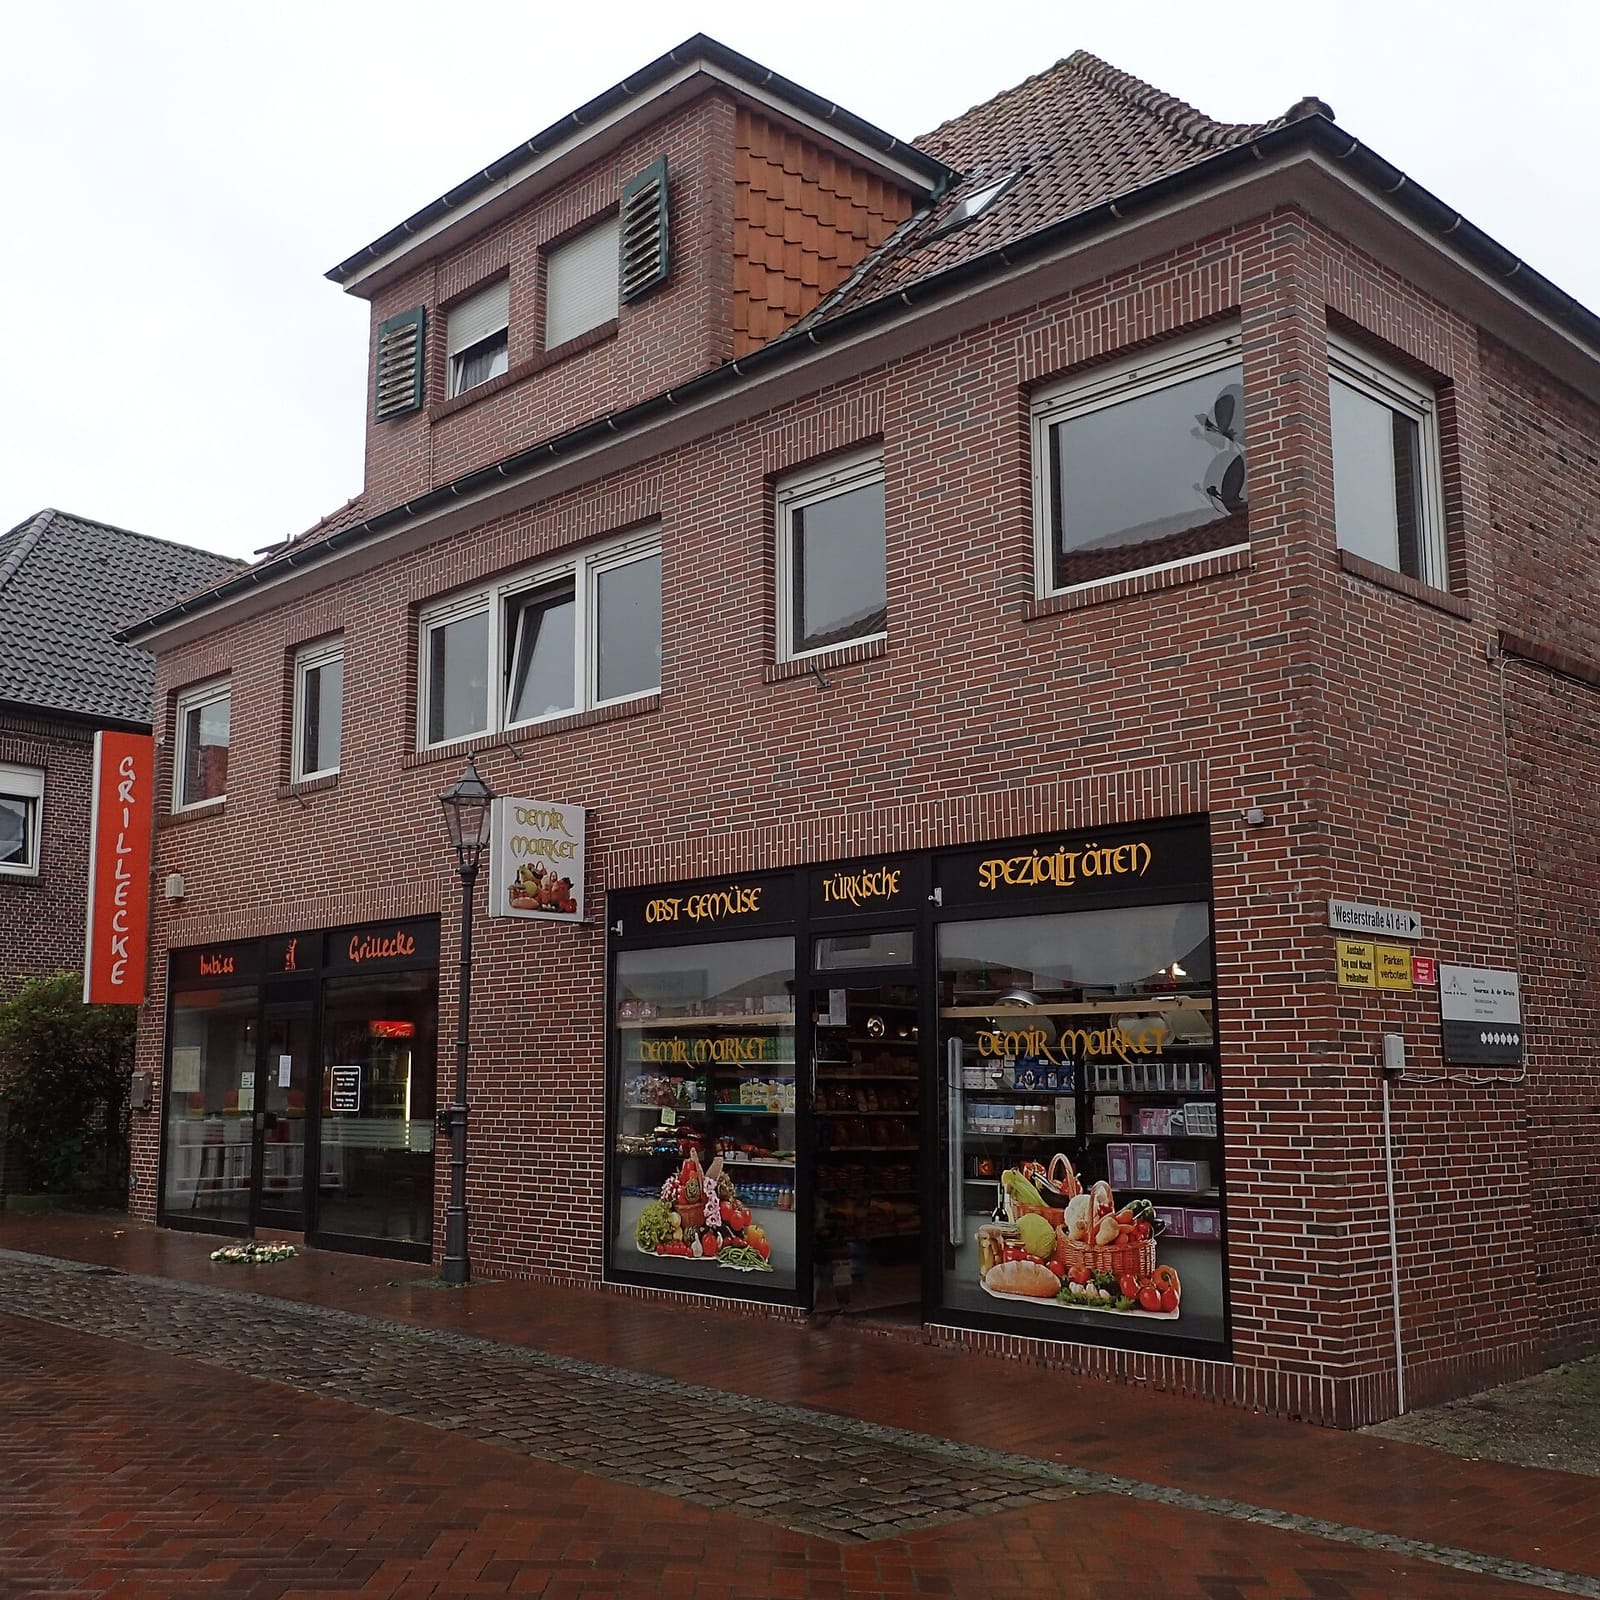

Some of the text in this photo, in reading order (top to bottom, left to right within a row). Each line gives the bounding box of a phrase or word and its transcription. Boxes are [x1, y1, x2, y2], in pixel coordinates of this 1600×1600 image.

[514, 806, 573, 837] DEMIR
[110, 756, 136, 985] GRILLECKE
[1334, 905, 1385, 928] Westerstraße
[349, 930, 416, 963] Grillecke
[1383, 954, 1404, 966] Parken
[200, 953, 235, 976] Imbiss
[639, 1035, 695, 1069] DEMIR
[976, 1024, 1061, 1065] DEMIR
